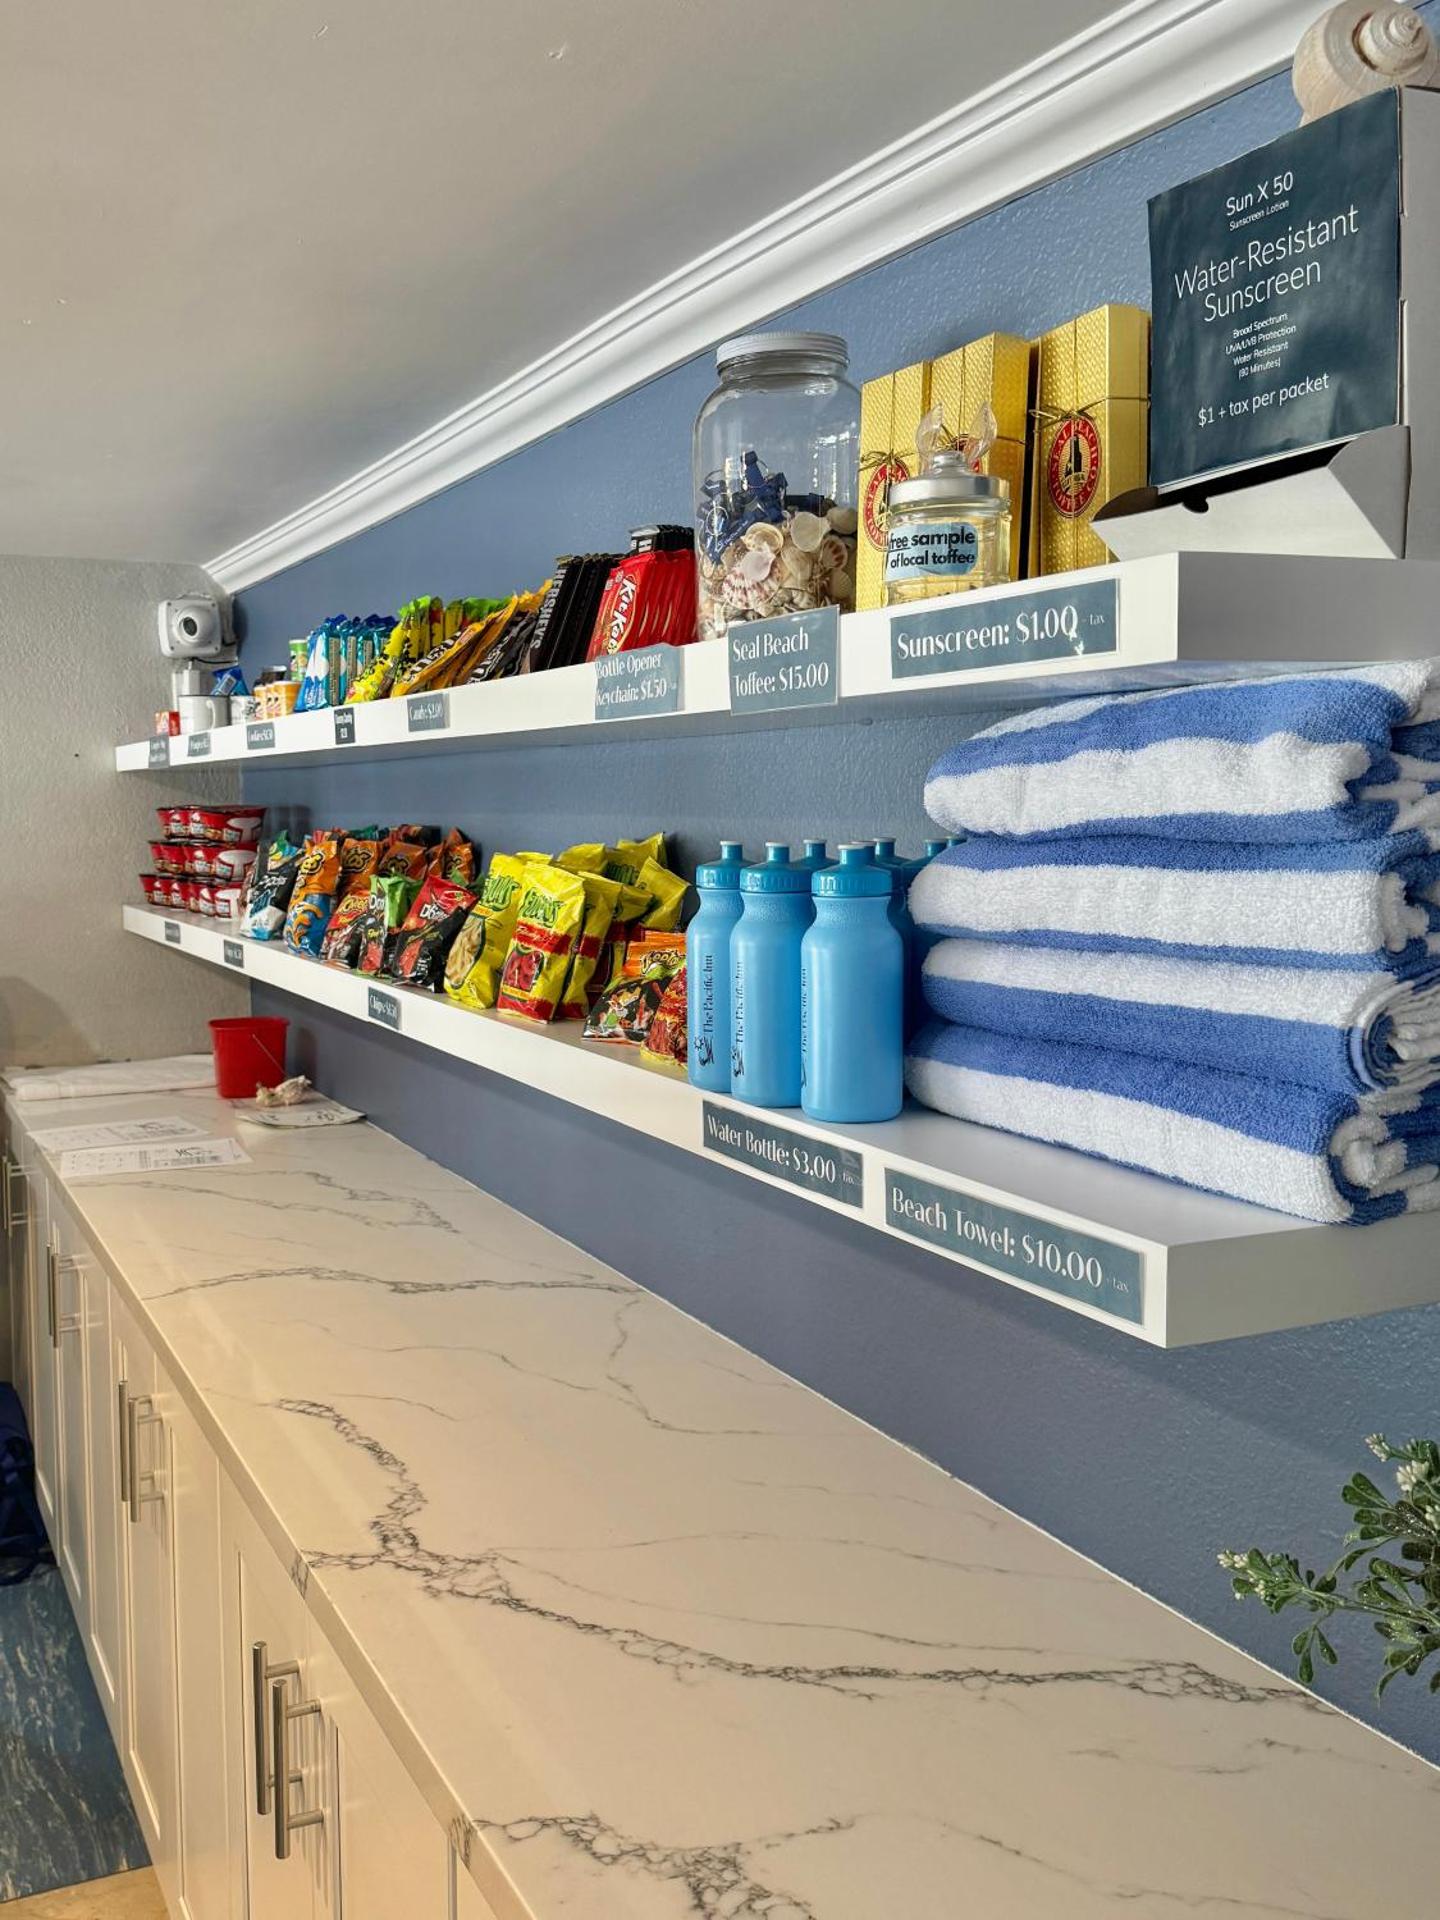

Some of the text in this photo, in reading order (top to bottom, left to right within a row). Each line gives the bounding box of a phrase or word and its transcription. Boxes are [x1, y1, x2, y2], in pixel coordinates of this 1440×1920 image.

[1226, 171, 1294, 217] Sun X 50
[1229, 199, 1290, 231] Sunscreen Lotion
[1174, 204, 1360, 300] Water-Resistant
[1203, 260, 1321, 323] Sunscreen
[1232, 312, 1289, 339] Broad Spectrum
[1257, 324, 1297, 344] Protection
[1232, 341, 1289, 366] Water Resistant
[1198, 372, 1330, 428] $1 + tax per packet
[890, 526, 976, 549] free sample
[890, 549, 975, 569] of local toffee
[529, 568, 567, 650] HERSHEY'S
[732, 626, 809, 663] Seal Beach
[897, 623, 1010, 660] Sunscreen:
[1016, 604, 1079, 645] $1.00
[595, 653, 663, 679] Bottle Opener
[733, 662, 830, 698] Toffee: $15.00
[640, 677, 667, 701] $1.50
[702, 954, 714, 1033] The Pacific Inn
[707, 1114, 743, 1148] Water
[745, 1130, 790, 1166] Bottle:
[793, 1147, 836, 1184] $3.00
[892, 1187, 1129, 1293] Beach Towel: $10.00 tax
